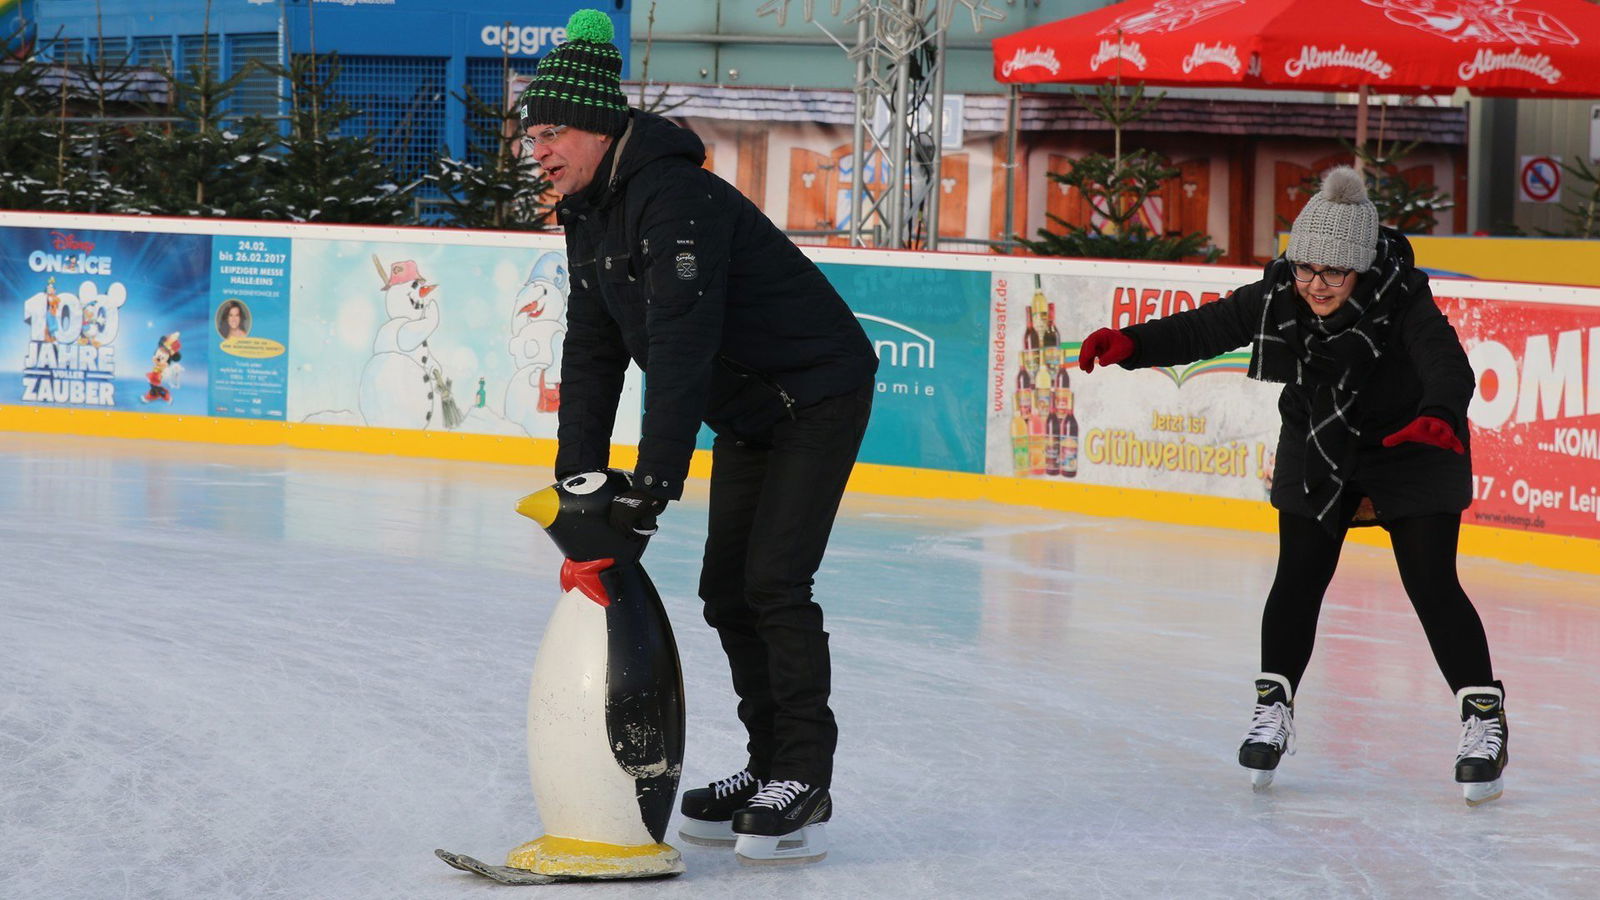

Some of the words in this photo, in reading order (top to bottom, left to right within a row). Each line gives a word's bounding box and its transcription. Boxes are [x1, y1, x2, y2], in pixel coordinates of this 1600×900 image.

[481, 25, 567, 54] aggre
[1284, 45, 1394, 79] Almdudler
[1457, 48, 1562, 85] Almdudler
[48, 230, 97, 256] Disney
[219, 250, 234, 261] bis
[235, 251, 287, 264] 26.02.2017
[238, 240, 268, 252] 24.02.
[220, 265, 259, 275] LEIPZIGER
[260, 267, 284, 276] MESSE
[24, 341, 114, 372] JAHRE
[994, 279, 1008, 412] www.heidesaft.de
[22, 377, 115, 406] ZAUBER
[876, 381, 935, 396] omie
[1467, 326, 1600, 430] OM
[1152, 410, 1185, 432] Jetzt
[1188, 414, 1207, 434] ist
[1084, 427, 1249, 478] Glühweinzeit
[1537, 427, 1600, 460] ...KOM
[1512, 478, 1564, 514] Oper
[1474, 511, 1546, 529] www.stomp.de
